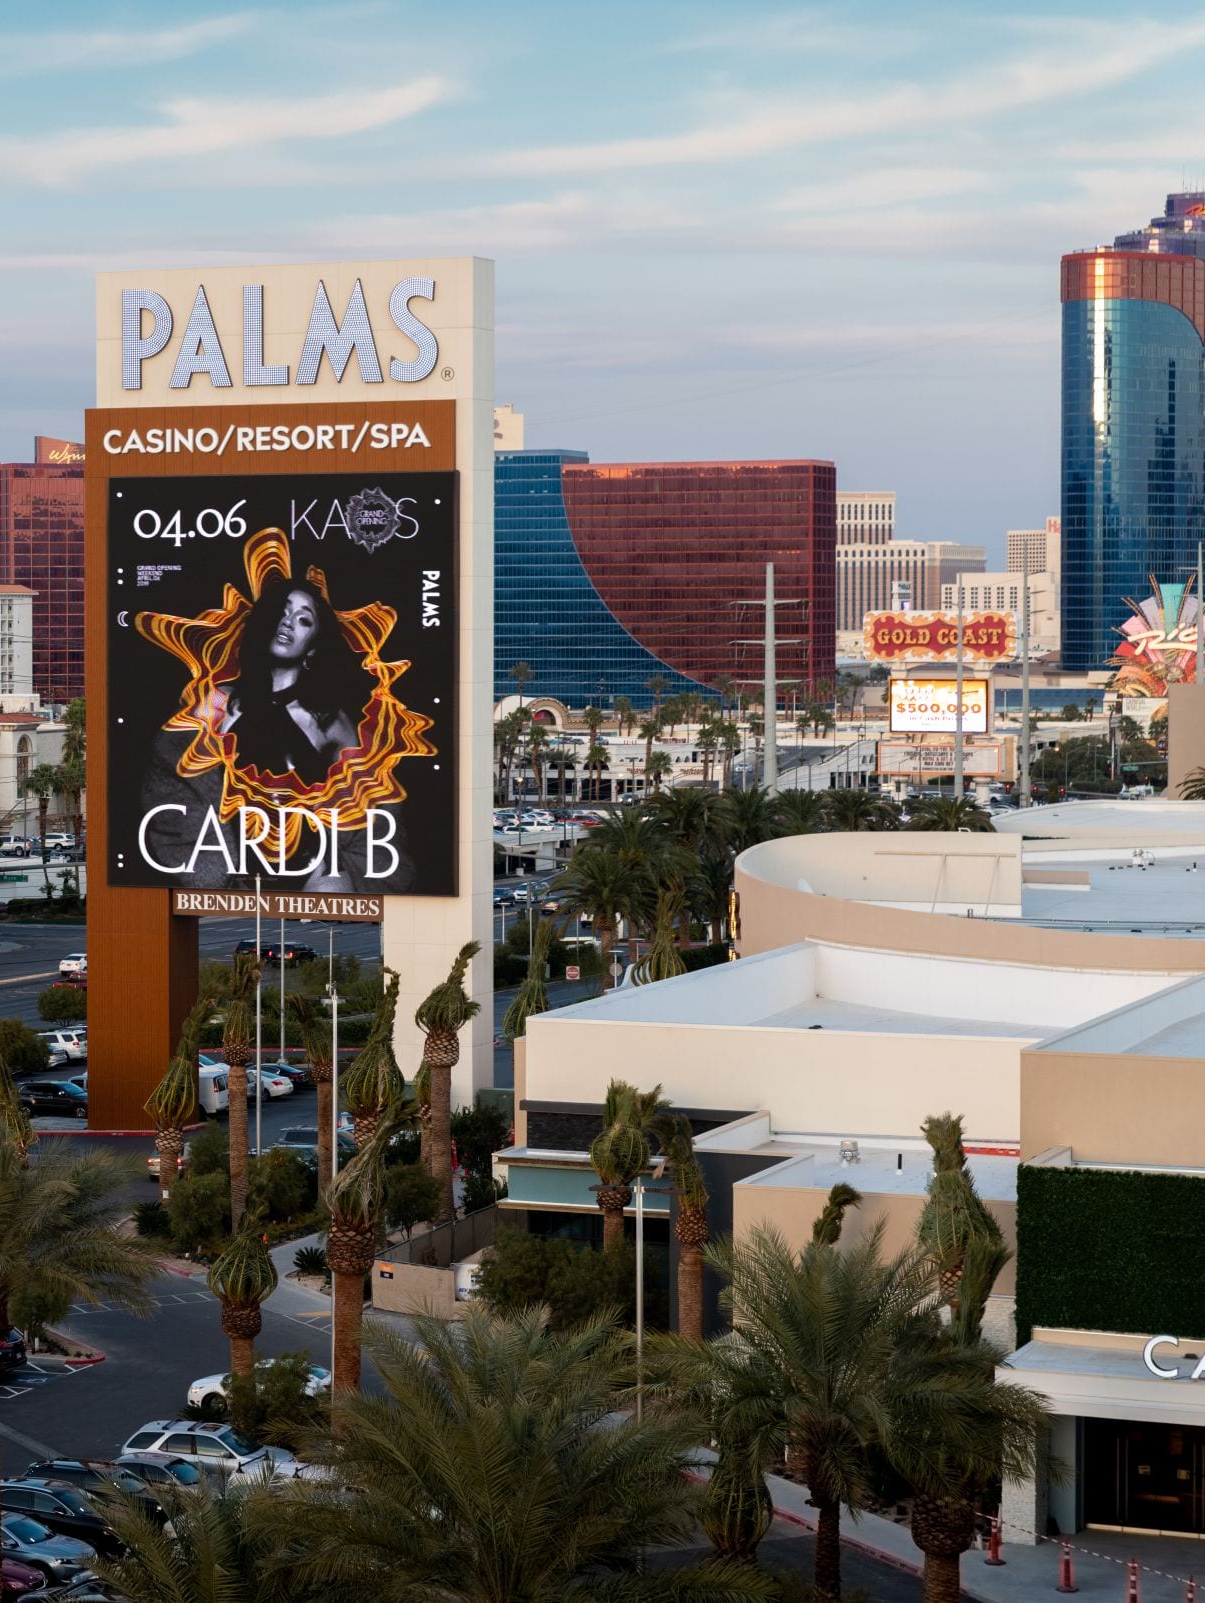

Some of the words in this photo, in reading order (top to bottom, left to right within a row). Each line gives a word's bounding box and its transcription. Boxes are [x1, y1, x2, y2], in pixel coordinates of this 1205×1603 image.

[122, 277, 439, 390] PALMS
[103, 420, 432, 456] CASINO/RESORT/SPA
[133, 499, 247, 547] 04.06
[360, 510, 385, 518] GRAND
[422, 570, 441, 627] PALMS
[877, 628, 931, 645] GOLD
[937, 628, 1002, 645] COAST
[896, 703, 982, 715] $500,000
[138, 803, 341, 877] CARDI
[364, 808, 399, 878] B
[176, 893, 270, 913] BRENDEN
[275, 896, 380, 916] THEATRES
